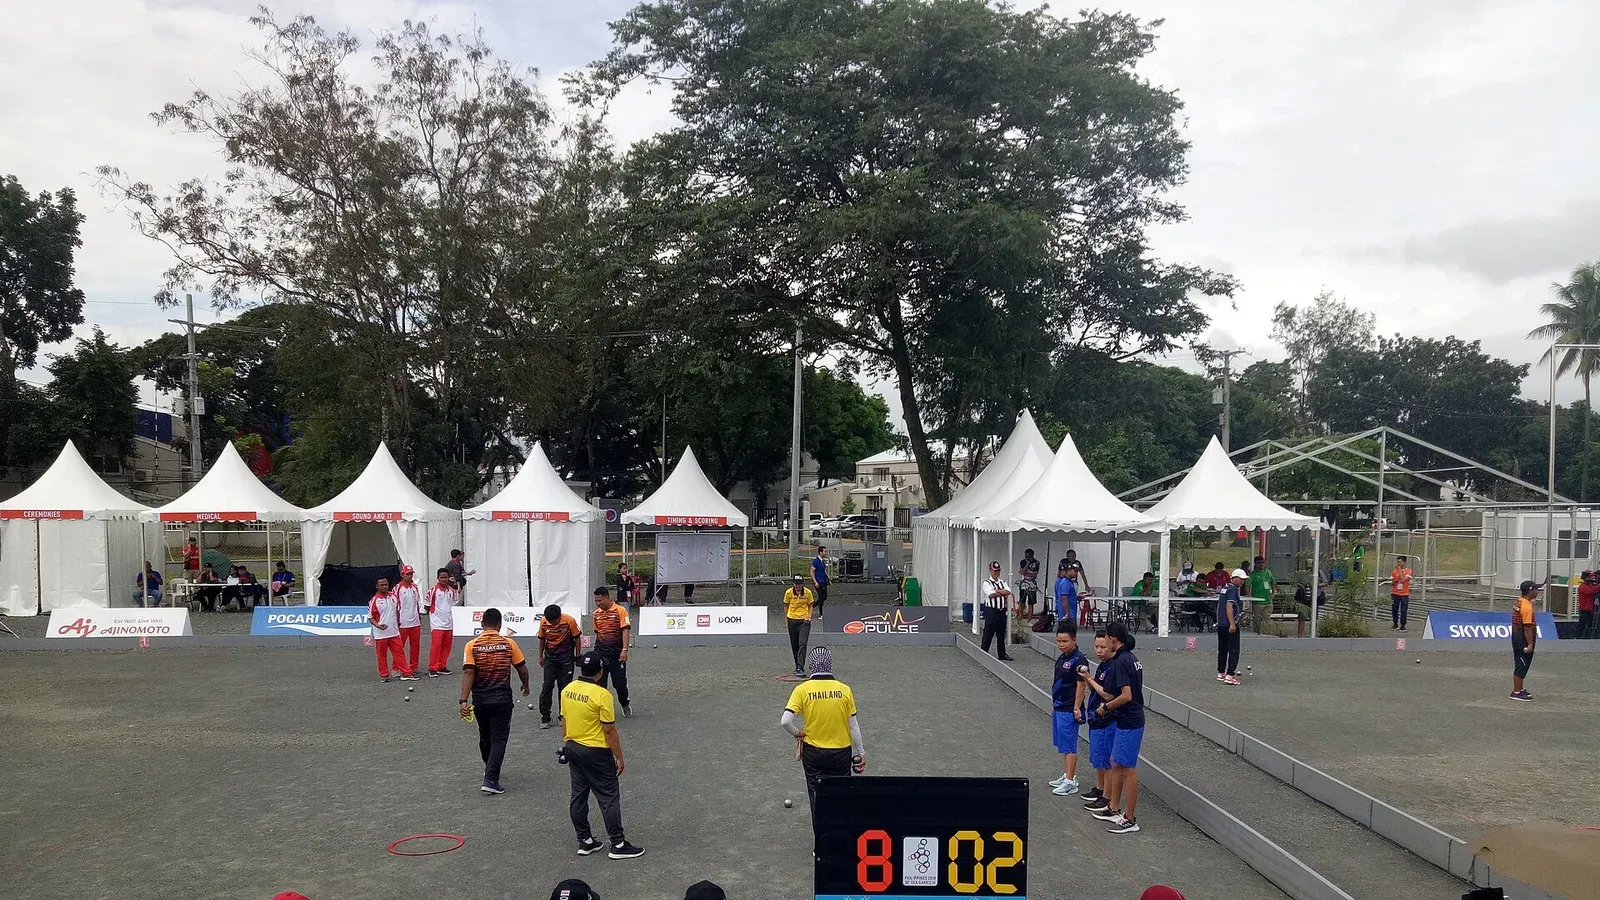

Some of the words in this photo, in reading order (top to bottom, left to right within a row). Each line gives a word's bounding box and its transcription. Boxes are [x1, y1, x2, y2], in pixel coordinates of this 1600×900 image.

[268, 614, 319, 624] POCARI
[322, 614, 368, 624] SWEAT
[100, 626, 170, 635] AJINOMOTO
[865, 625, 918, 634] PULSE
[564, 690, 589, 704] THAILAND
[808, 690, 842, 700] THAILAND
[857, 830, 892, 892] 8
[948, 830, 1024, 894] 02
